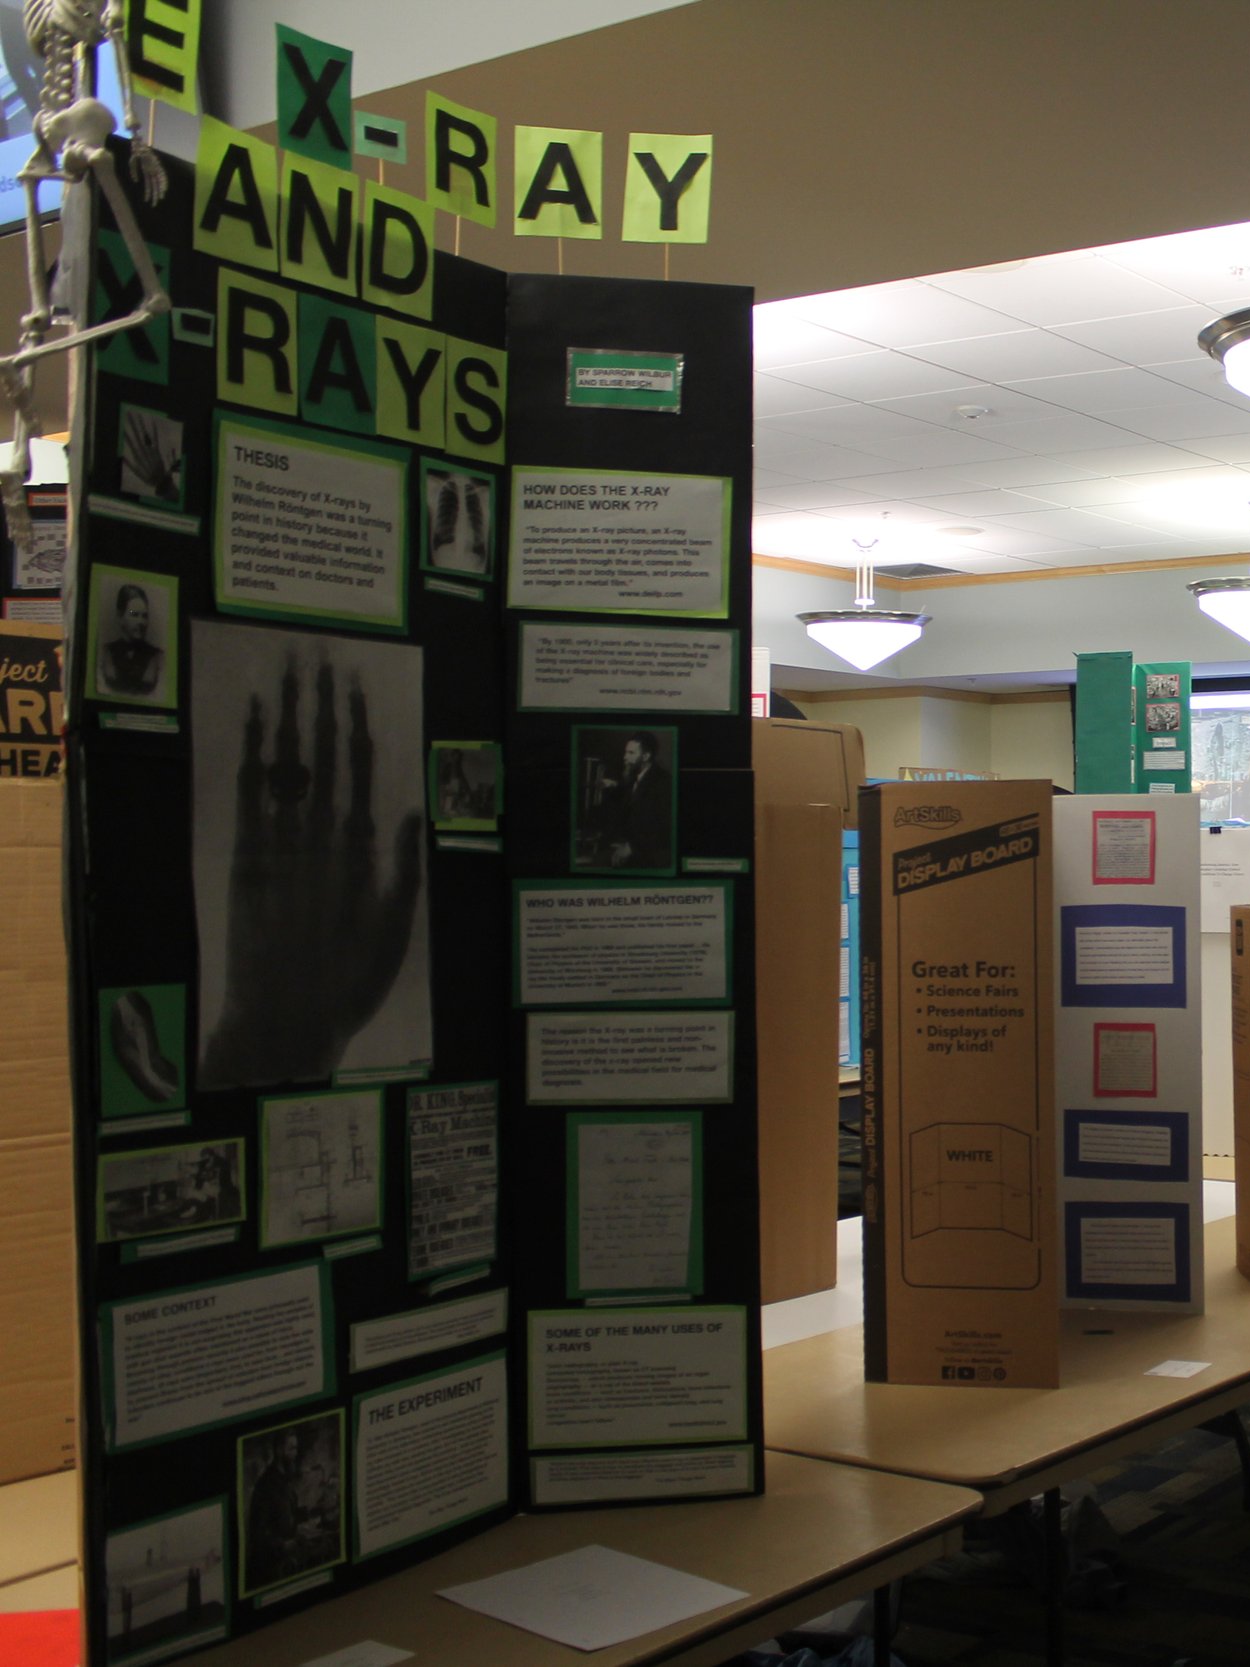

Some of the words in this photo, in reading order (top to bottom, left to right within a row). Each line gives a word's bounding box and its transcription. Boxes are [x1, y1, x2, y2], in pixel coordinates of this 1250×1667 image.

[201, 145, 429, 294] AND
[99, 243, 501, 446] X-RAYS
[234, 446, 289, 470] THESIS
[233, 477, 252, 491] The
[255, 481, 307, 503] discovery
[310, 491, 323, 504] of
[324, 493, 356, 512] X-rays
[359, 500, 371, 515] by
[523, 485, 556, 496] HOW
[560, 485, 597, 496] DOES
[600, 485, 626, 496] THE
[630, 486, 670, 497] X-RAY
[523, 500, 585, 510] MACHINE
[589, 500, 630, 511] WORK
[635, 501, 658, 511] ???
[232, 509, 259, 527] point
[263, 514, 273, 526] in
[276, 516, 313, 535] history
[316, 522, 358, 539] because
[361, 529, 368, 541] it
[231, 542, 279, 562] provided
[283, 549, 327, 566] valuable
[330, 556, 385, 574] information
[232, 558, 252, 571] and
[255, 561, 295, 577] context
[299, 569, 312, 579] on
[315, 569, 353, 585] doctors
[356, 575, 374, 588] and
[895, 805, 963, 822] ArtSkills
[898, 854, 968, 887] DISPLAY
[971, 837, 1033, 868] BOARD
[526, 898, 554, 908] WHO
[558, 897, 584, 907] WAS
[587, 896, 641, 907] WILHELM
[912, 960, 969, 978] Great
[975, 961, 1015, 978] For:
[926, 984, 981, 997] Science
[985, 985, 1019, 997] Fairs
[926, 1005, 1025, 1017] Presentations
[927, 1025, 988, 1040] Displays
[992, 1025, 1008, 1037] of
[927, 1042, 952, 1055] any
[956, 1040, 994, 1052] kind!
[865, 1048, 875, 1094] BOARD
[865, 1096, 876, 1146] DISPLAY
[946, 1150, 994, 1162] WHITE
[124, 1308, 158, 1325] SOME
[161, 1296, 217, 1318] CONTEXT
[546, 1328, 582, 1339] SOME
[585, 1328, 600, 1338] OF
[606, 1327, 629, 1336] THE
[632, 1325, 668, 1335] MANY
[671, 1324, 703, 1334] USES
[706, 1323, 723, 1333] OF
[546, 1342, 591, 1353] X-RAYS
[369, 1404, 394, 1425] THE
[398, 1376, 483, 1416] EXPERIMENT
